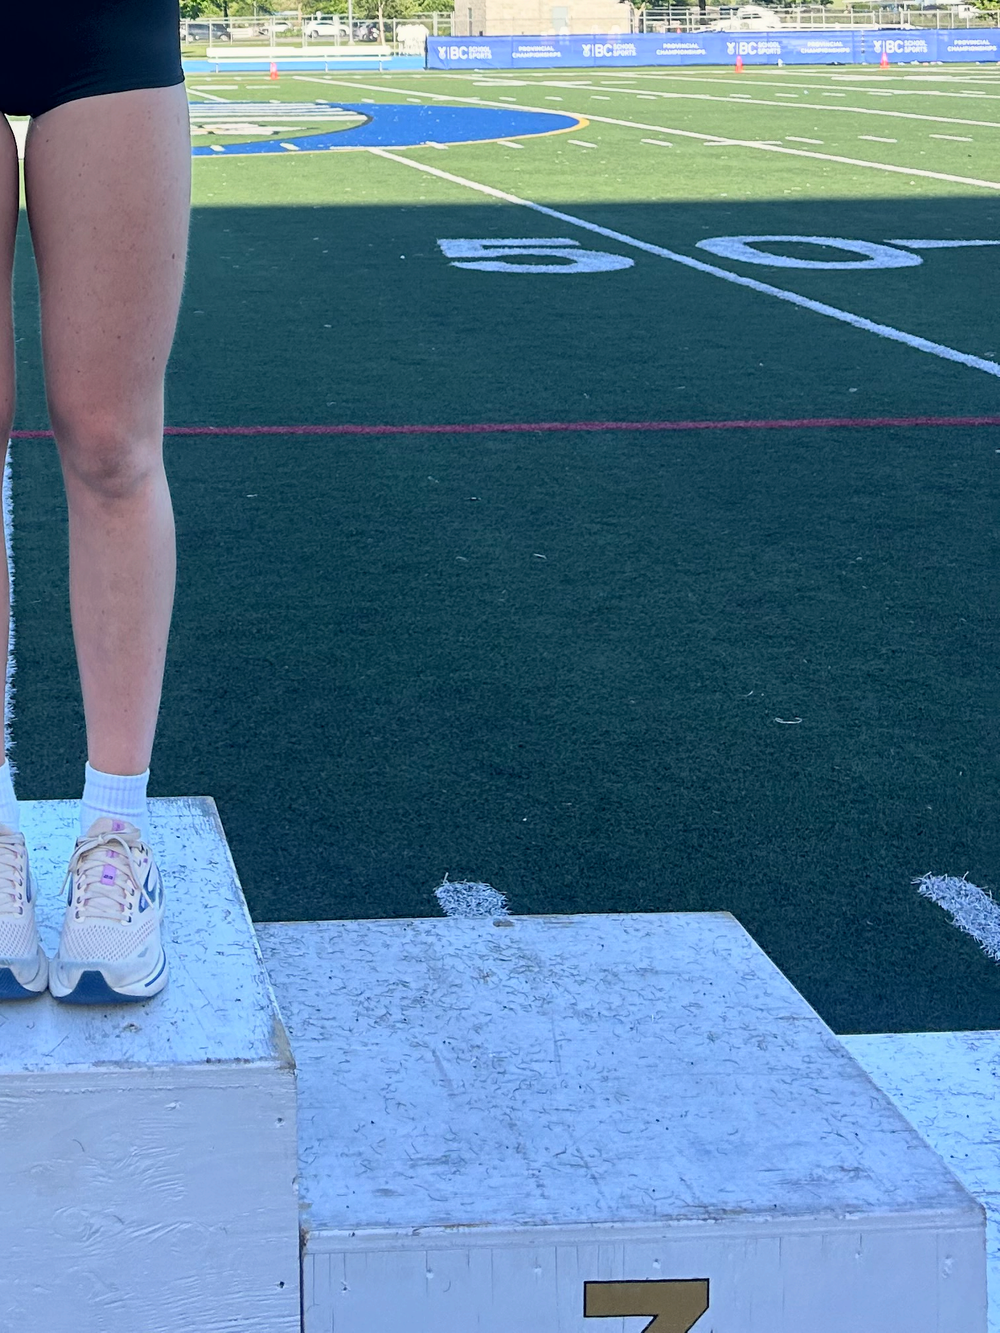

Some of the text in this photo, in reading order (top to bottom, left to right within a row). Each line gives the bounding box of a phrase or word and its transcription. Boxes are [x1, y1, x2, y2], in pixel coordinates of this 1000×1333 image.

[450, 46, 468, 60] BC
[595, 44, 612, 57] BC
[739, 42, 757, 55] BC
[886, 40, 903, 53] BC
[512, 51, 561, 59] CHAMPIONSHIPS
